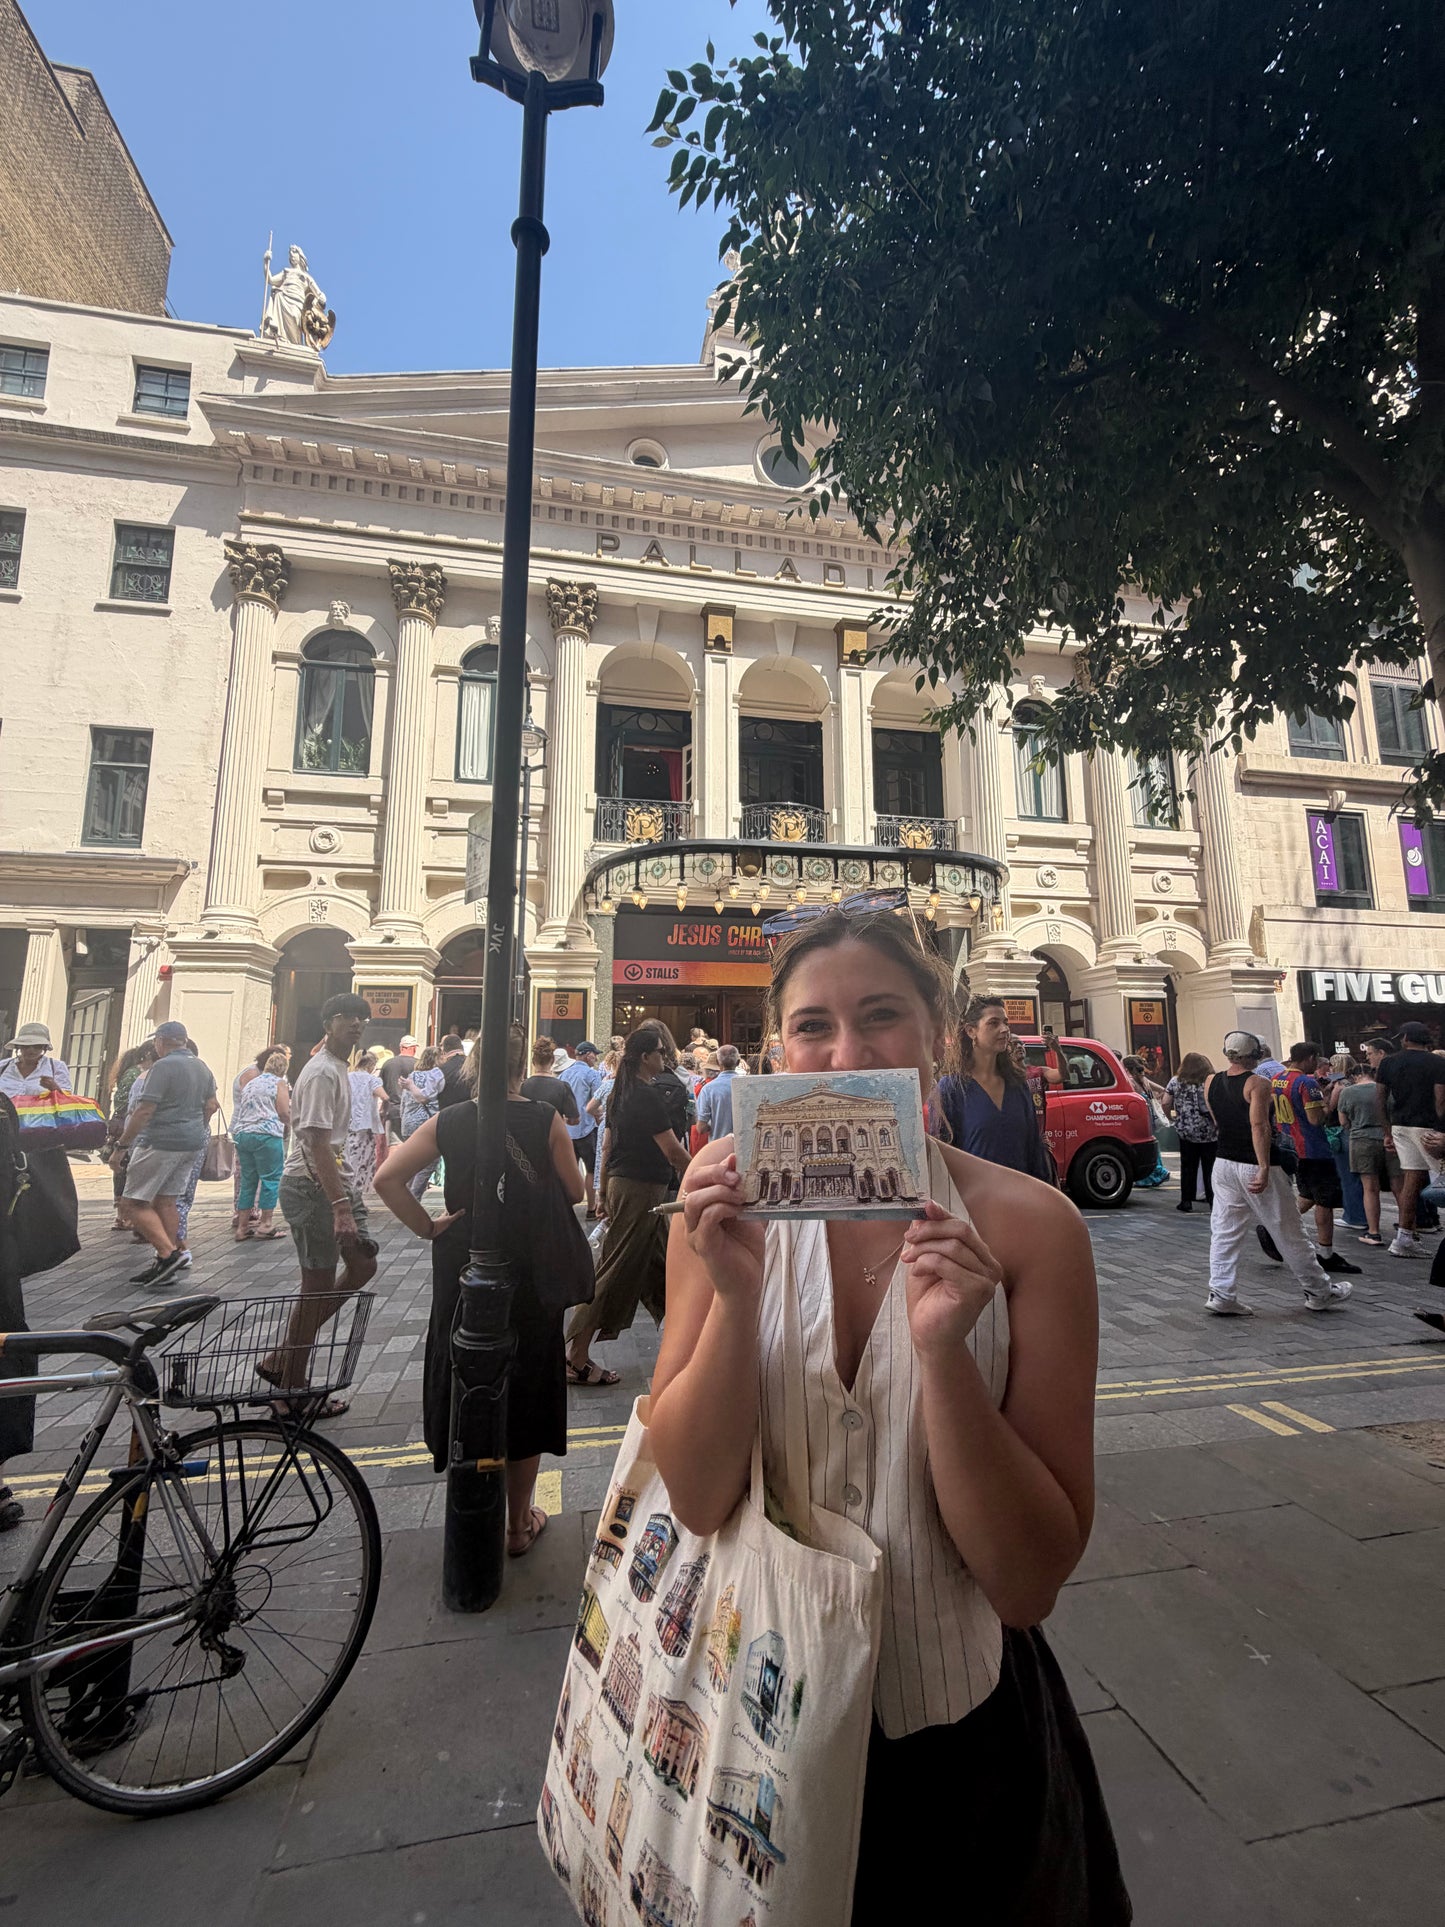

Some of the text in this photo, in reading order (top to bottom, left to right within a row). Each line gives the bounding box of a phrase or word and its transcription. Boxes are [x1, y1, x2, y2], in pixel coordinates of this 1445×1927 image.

[597, 533, 902, 596] PALLADI
[1315, 819, 1331, 880] ACAI
[667, 924, 777, 948] JESUS CHRI
[646, 967, 680, 980] STALLS
[1312, 971, 1445, 1004] FIVE GU
[1065, 1129, 1078, 1139] get
[731, 1722, 789, 1782] Cambridge Theatre
[657, 1794, 683, 1825] Theatre
